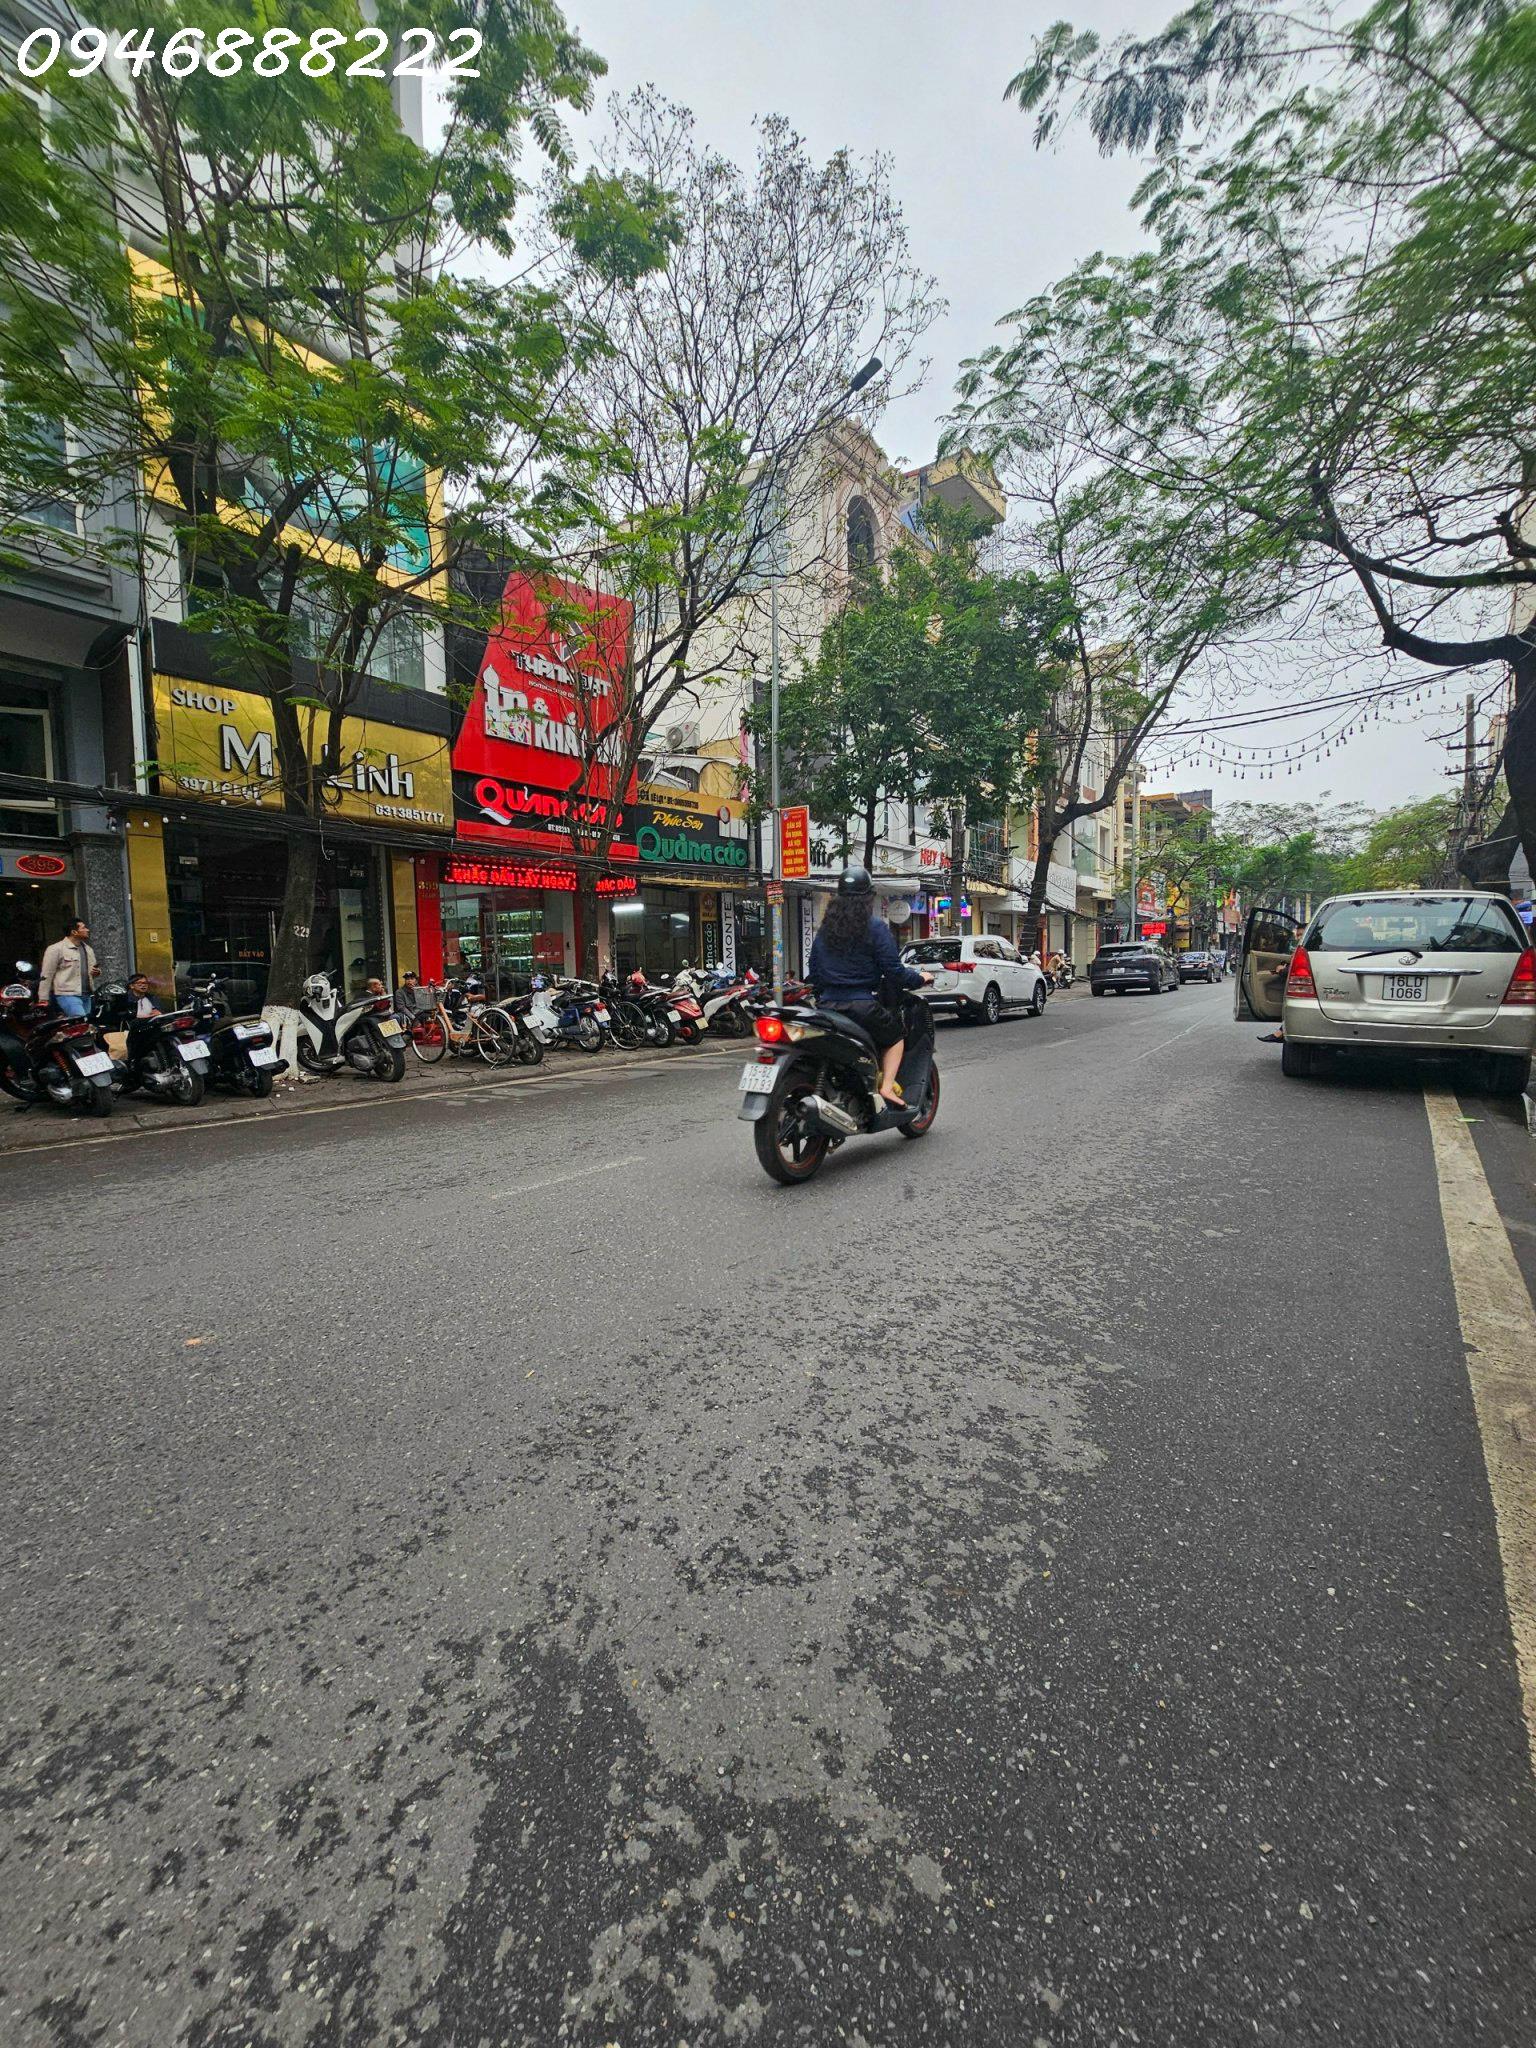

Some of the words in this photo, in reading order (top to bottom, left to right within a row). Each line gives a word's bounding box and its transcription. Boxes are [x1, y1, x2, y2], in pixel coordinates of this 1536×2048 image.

[172, 688, 238, 715] SHOP
[637, 826, 713, 862] Quảng
[714, 840, 748, 867] cáo
[517, 869, 539, 886] LẤY
[542, 874, 571, 887] NGAY
[1389, 976, 1424, 987] 16LD
[1389, 988, 1422, 999] 1066
